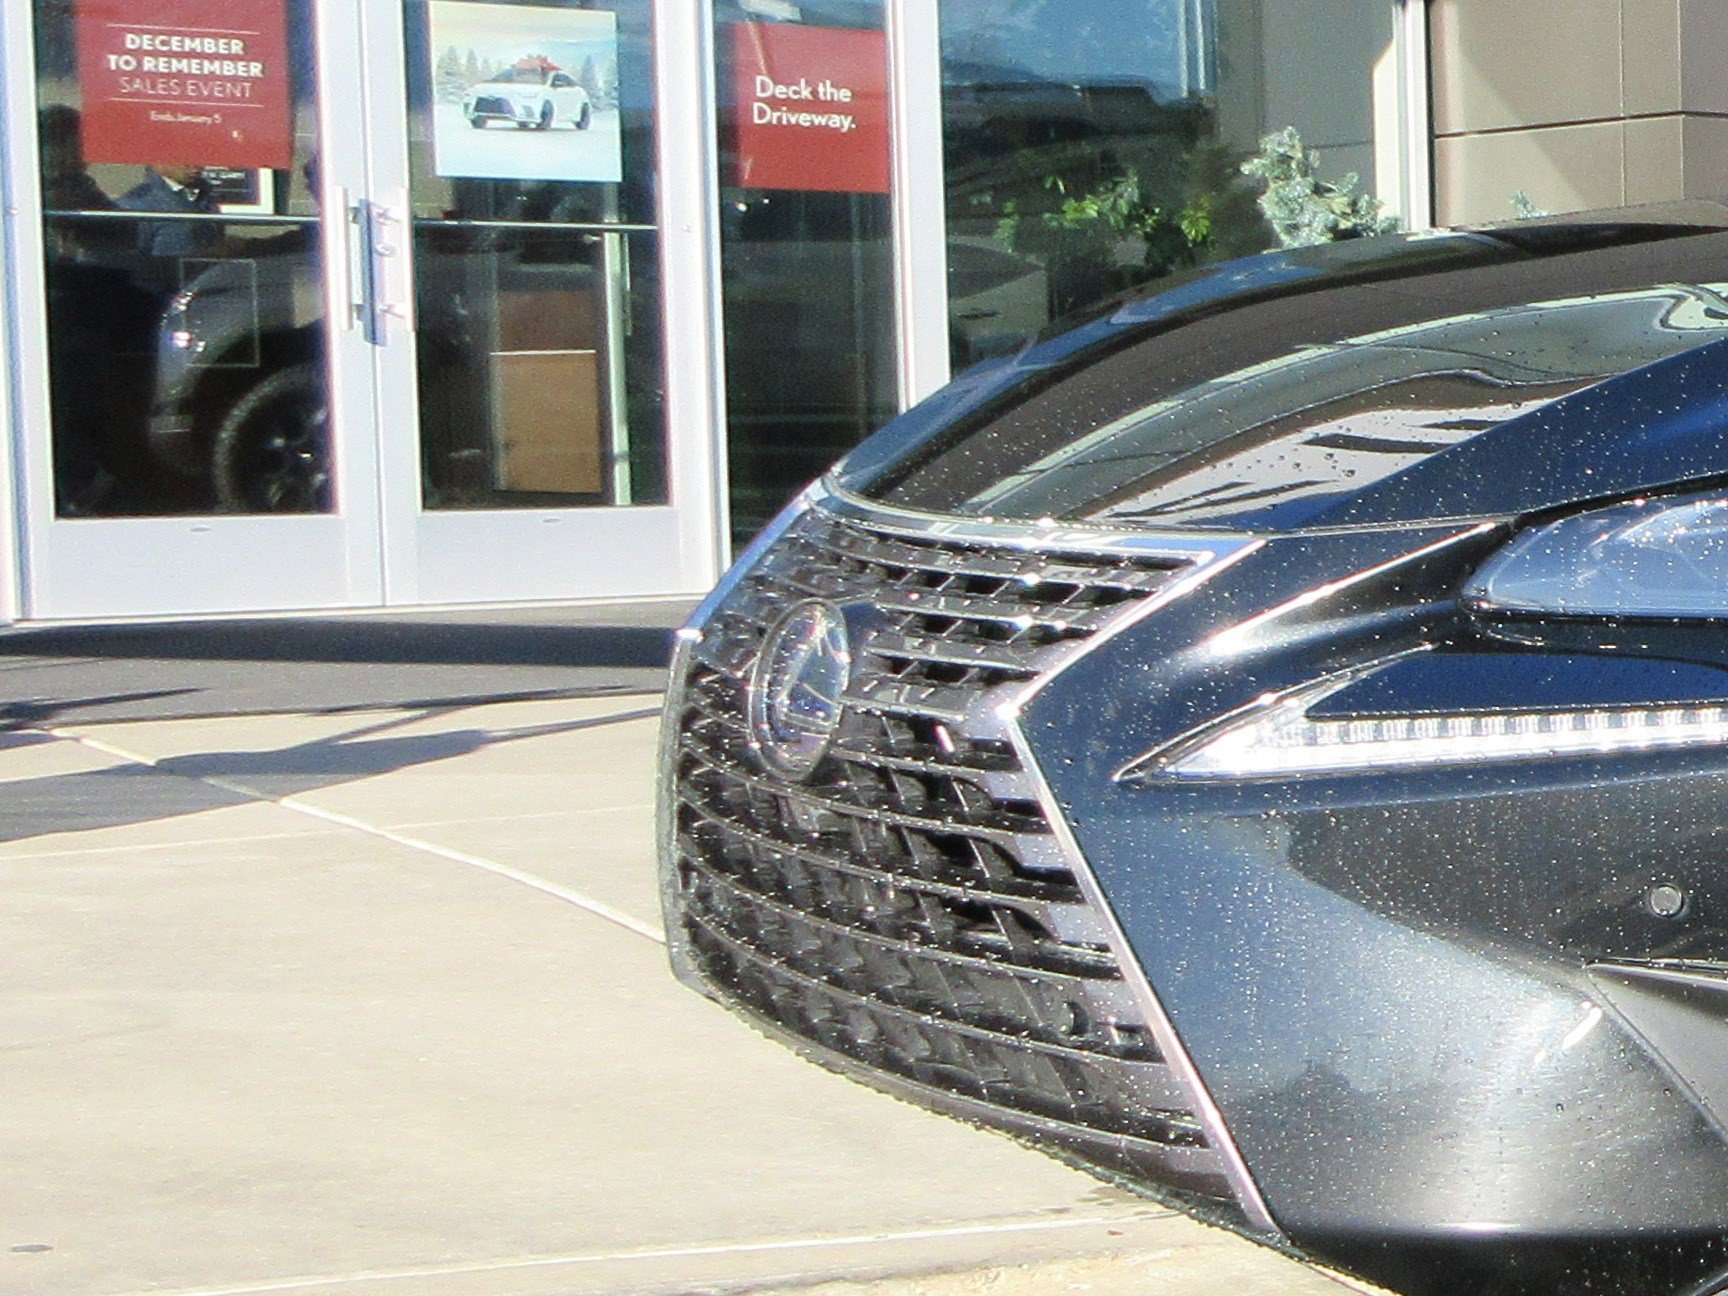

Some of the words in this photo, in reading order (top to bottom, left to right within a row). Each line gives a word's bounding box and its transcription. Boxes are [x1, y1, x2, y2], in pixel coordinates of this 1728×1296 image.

[124, 33, 246, 55] DECEMBER
[107, 54, 138, 72] TO
[142, 56, 265, 79] REMEMBER
[119, 77, 181, 96] SALES
[187, 80, 253, 98] EVENT
[755, 75, 814, 100] Deck
[817, 78, 853, 103] the
[752, 101, 857, 133] Driveway.
